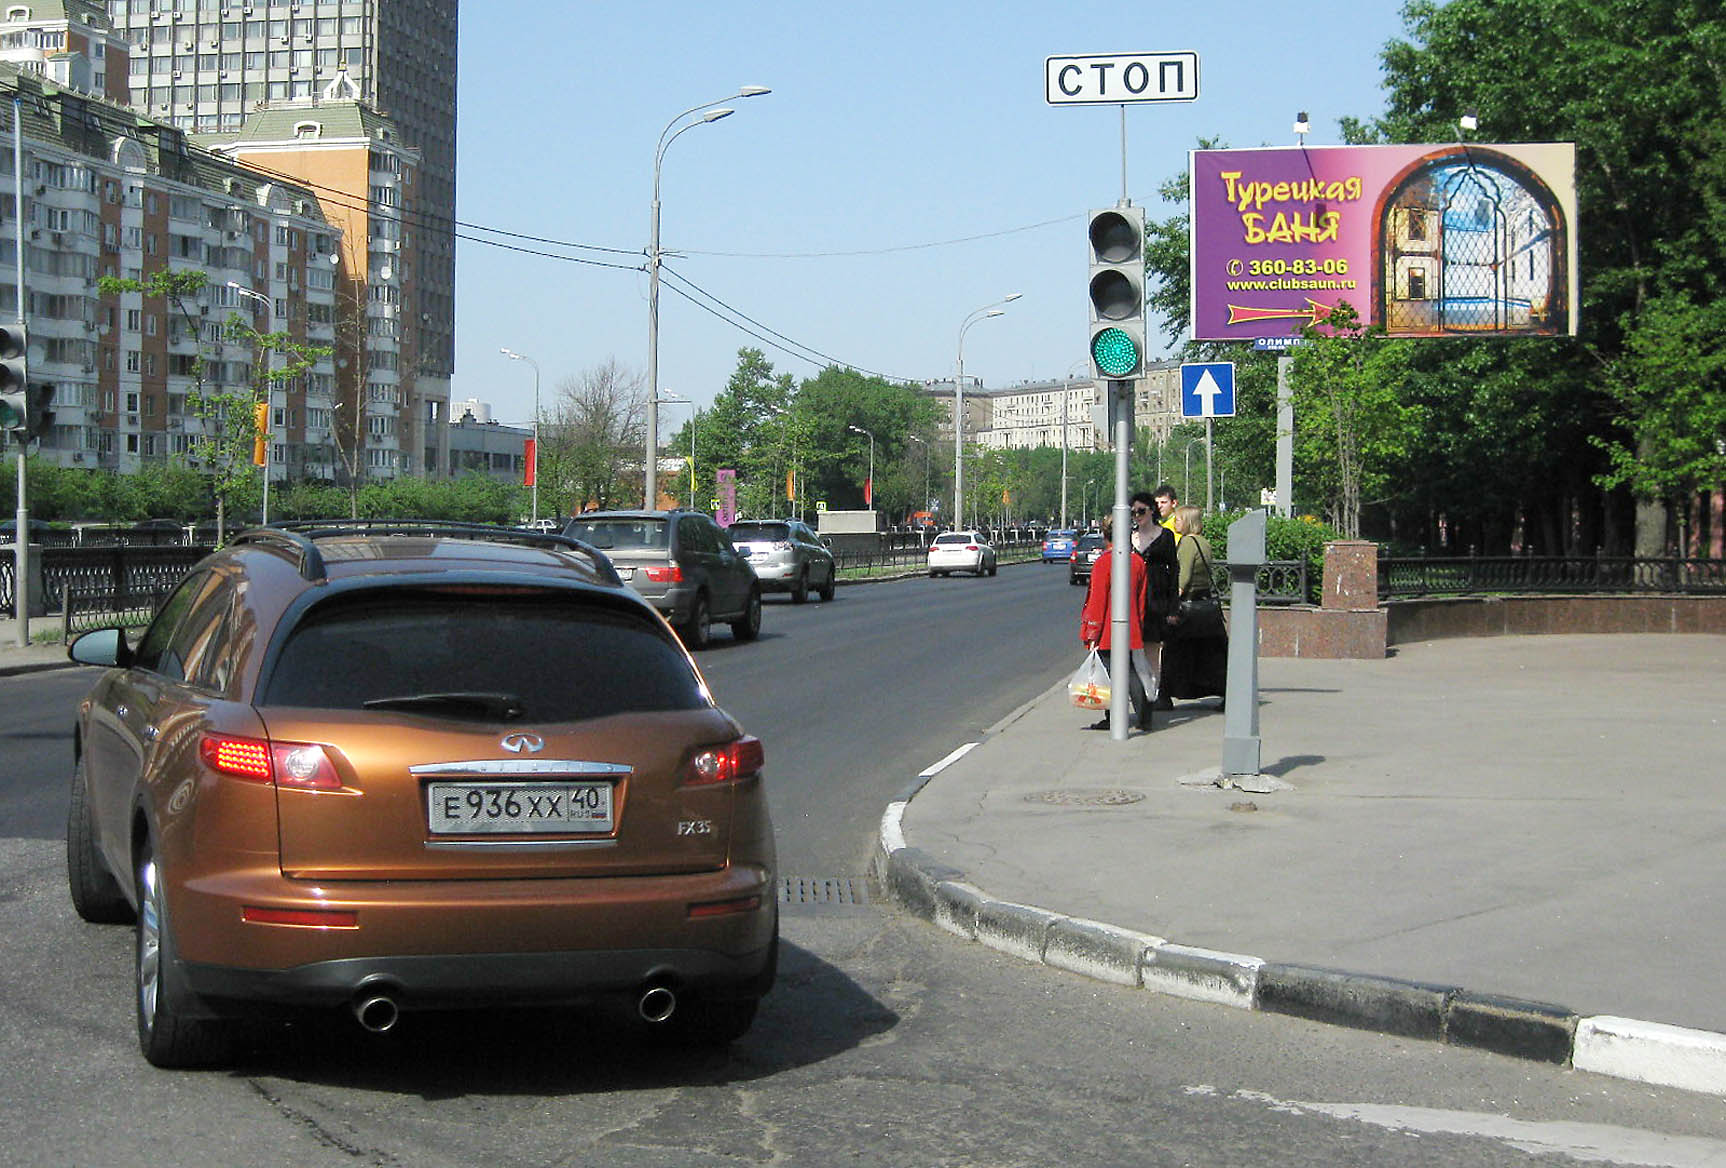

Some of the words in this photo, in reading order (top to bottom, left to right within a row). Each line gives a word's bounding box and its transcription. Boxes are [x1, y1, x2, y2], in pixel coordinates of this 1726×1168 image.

[1058, 61, 1184, 96] СТОП
[1221, 171, 1362, 211] Турецкая
[1242, 211, 1340, 244] БАНЯ
[1249, 259, 1348, 275] 360-83-06
[1227, 278, 1356, 290] www.clubsaun.ru
[572, 788, 599, 808] 40
[678, 820, 711, 835] FX35
